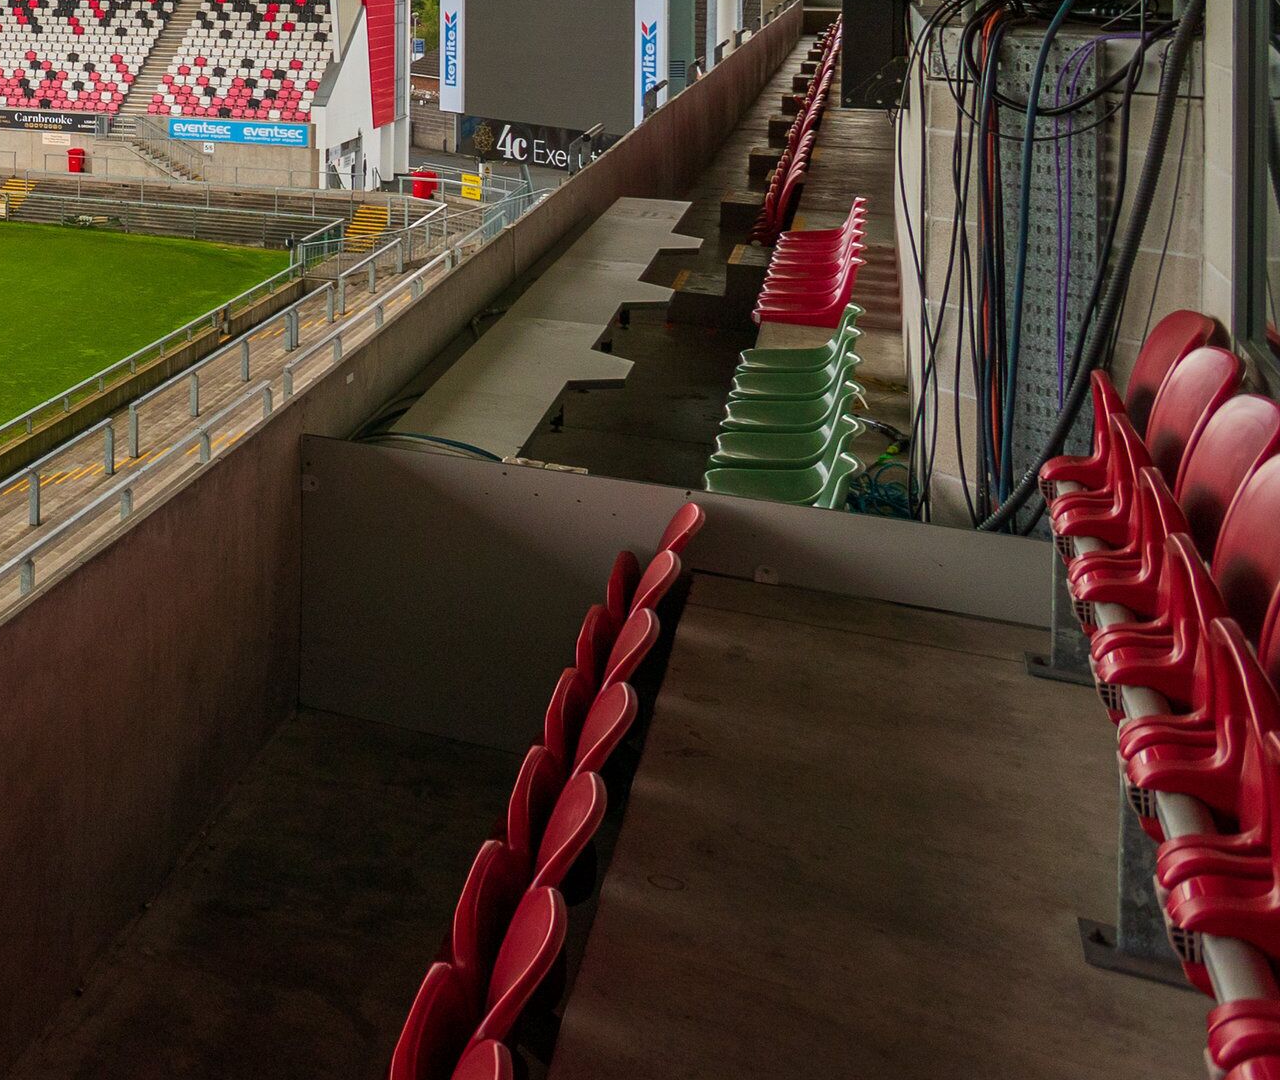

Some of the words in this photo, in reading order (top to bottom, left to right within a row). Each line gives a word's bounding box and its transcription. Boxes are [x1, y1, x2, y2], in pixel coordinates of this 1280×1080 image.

[446, 31, 457, 86] keylite
[642, 41, 656, 94] eylite
[14, 112, 73, 125] Carnbrooke
[173, 122, 231, 135] eventsec
[243, 126, 304, 139] eventsec
[496, 124, 528, 160] 4c
